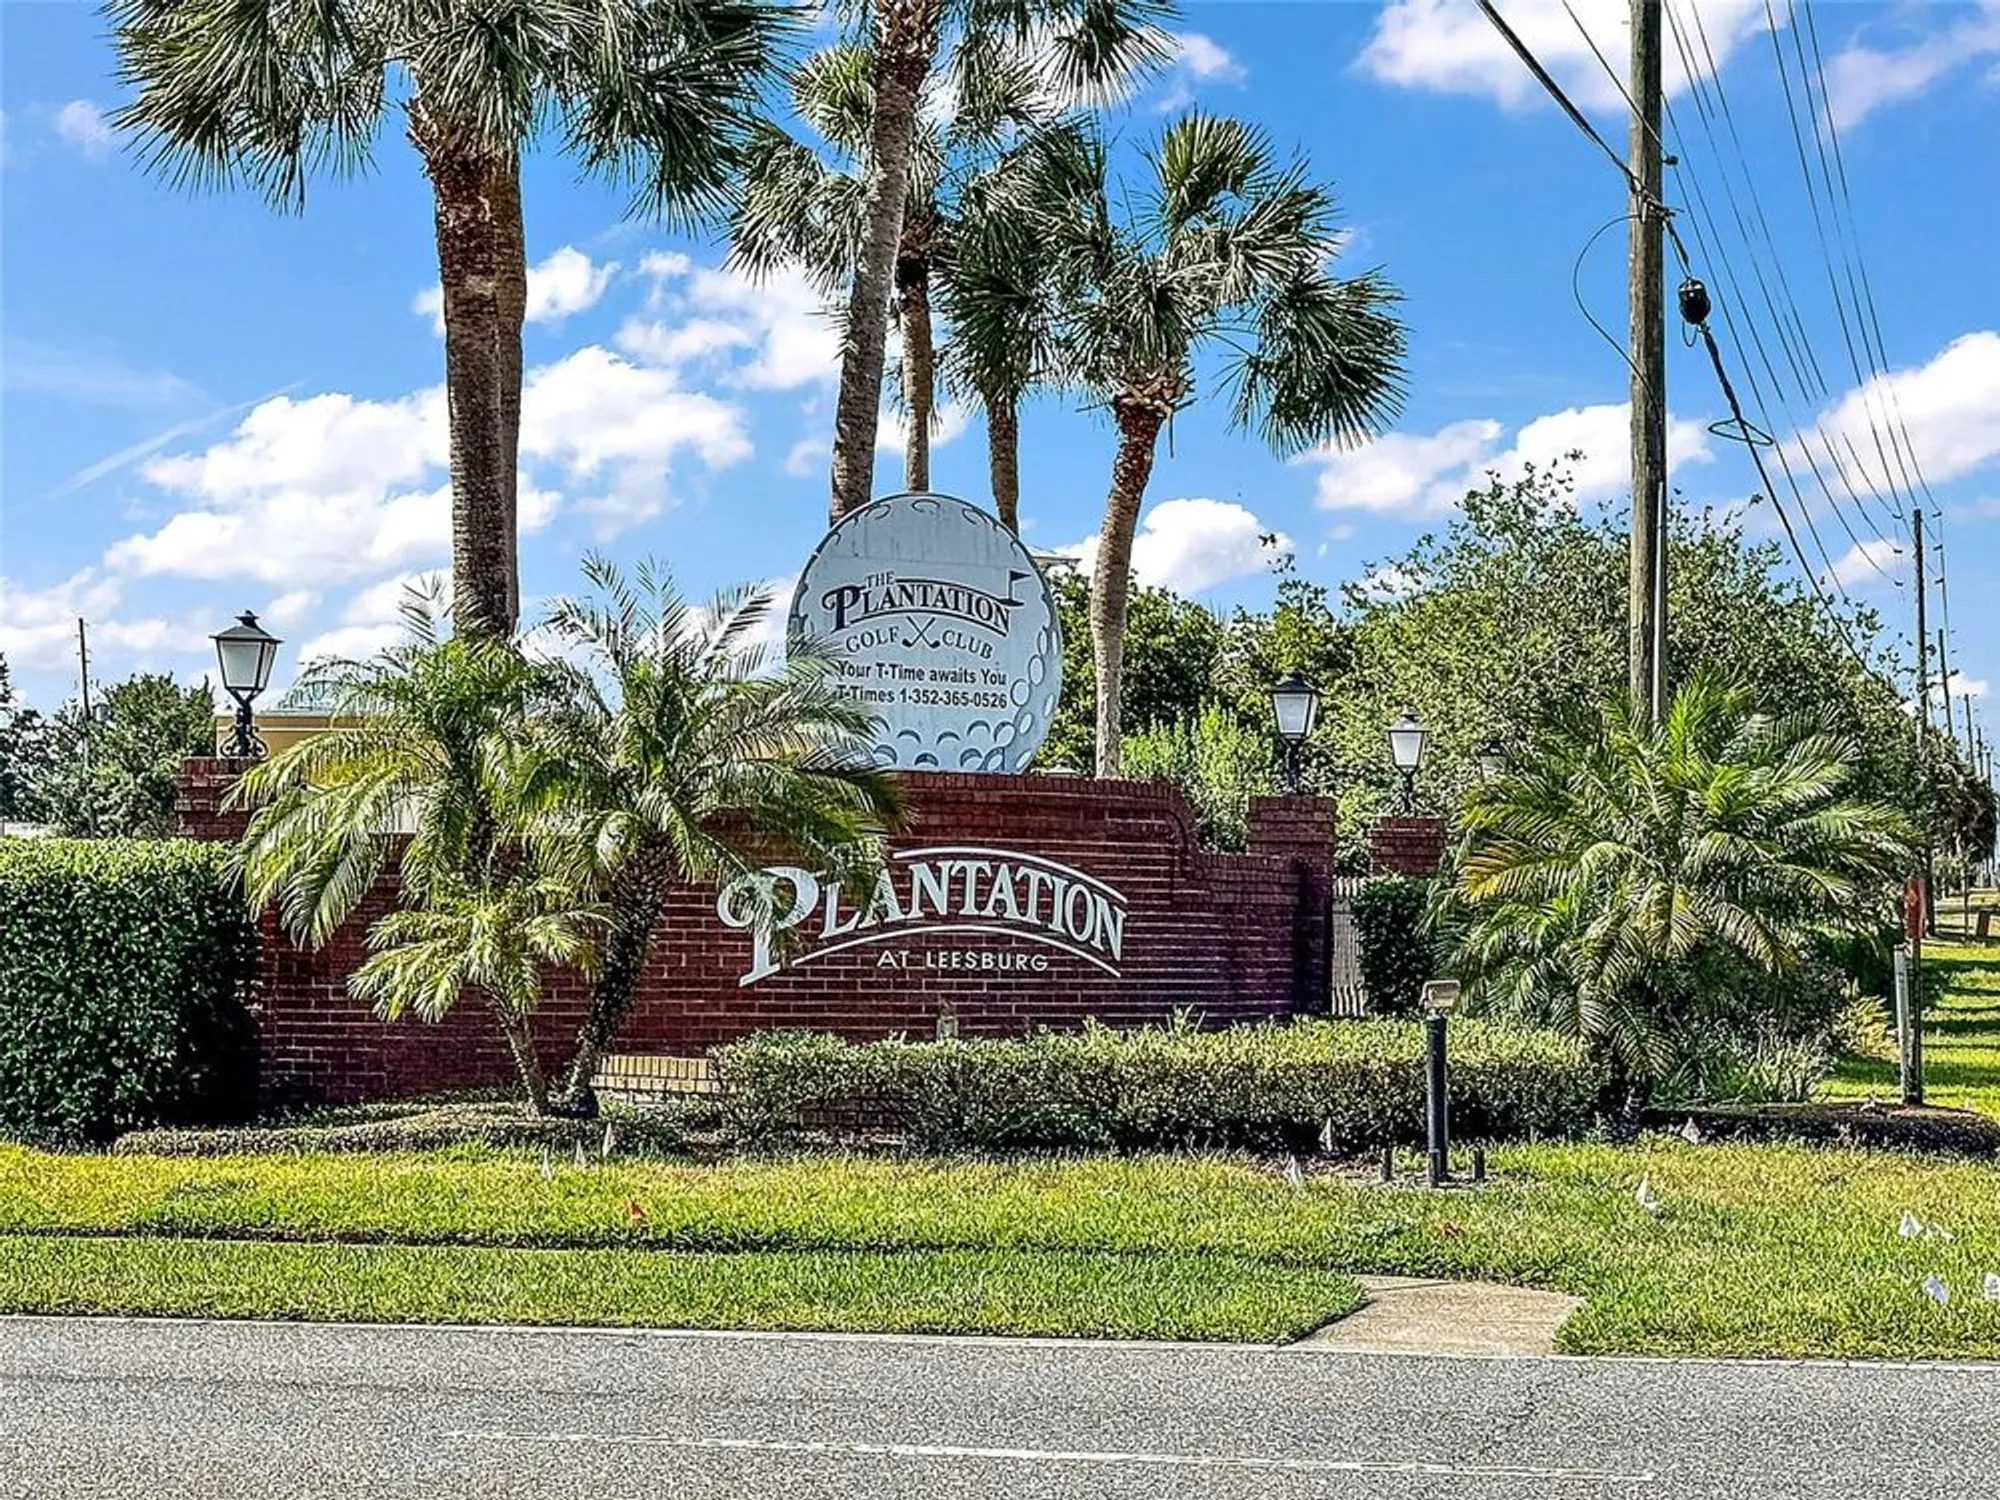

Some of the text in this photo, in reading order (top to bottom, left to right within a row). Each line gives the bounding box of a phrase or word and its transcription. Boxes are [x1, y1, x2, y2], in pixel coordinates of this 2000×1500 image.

[866, 571, 895, 588] THE
[822, 584, 1011, 635] PLANTATION
[846, 626, 993, 659] GOLF CLUB
[838, 660, 1007, 686] Your T-Time awaits You
[836, 685, 1008, 709] T-Times 1-352-365-0526
[717, 859, 1128, 988] PLANTATION
[877, 950, 1049, 971] AT LEESBURG
